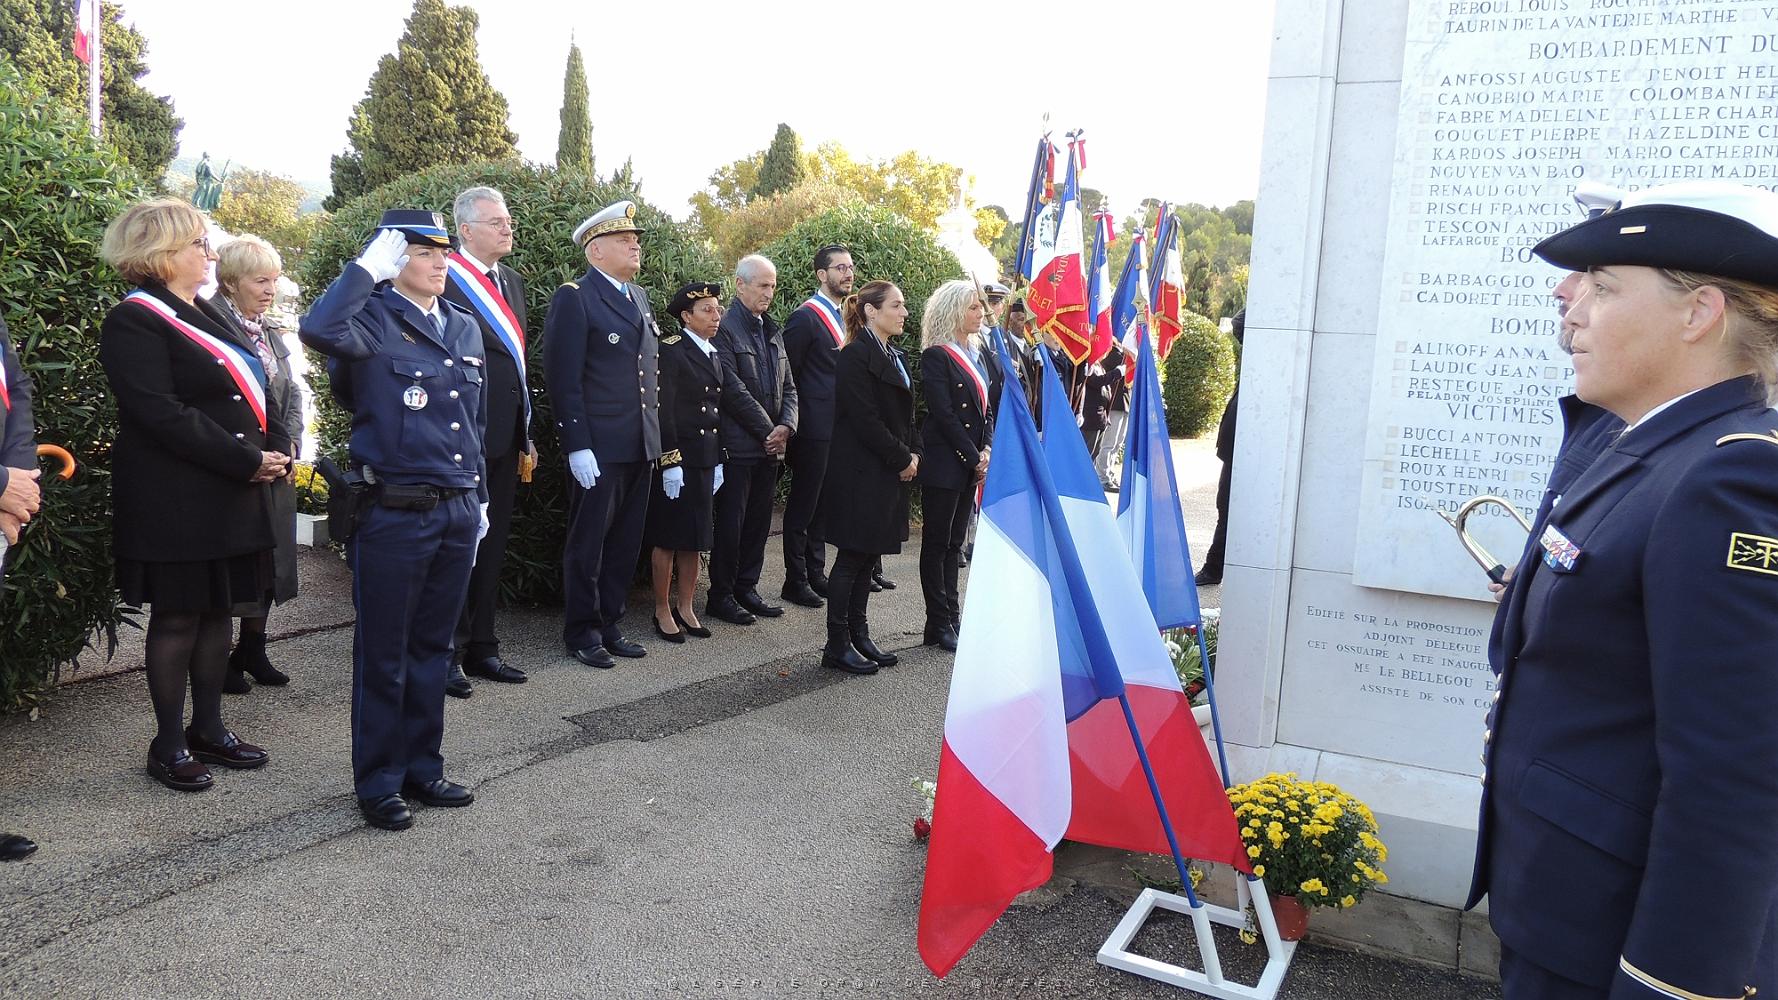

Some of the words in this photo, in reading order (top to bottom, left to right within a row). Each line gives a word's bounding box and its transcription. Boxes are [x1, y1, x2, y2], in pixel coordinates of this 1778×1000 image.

[1449, 1, 1512, 15] REBOUL
[1519, 0, 1569, 12] LOUIS
[1445, 18, 1508, 33] TAURIN
[1513, 18, 1533, 30] DE
[1539, 17, 1560, 30] LA
[1565, 12, 1653, 29] VANTERIE
[1659, 9, 1737, 26] MARTHE
[1761, 8, 1778, 19] V
[1528, 36, 1733, 59] BOMBARDEMENT
[1440, 73, 1525, 87] ANFOSSI
[1531, 70, 1621, 84] AUGUSTE
[1542, 89, 1603, 103] MARIE
[1630, 86, 1751, 102] COLOMBANI
[1437, 111, 1494, 124] FABRE
[1500, 108, 1609, 123] MADELEINE
[1531, 128, 1601, 141] PIERRE
[1628, 125, 1750, 140] HAZELDINE
[1432, 147, 1505, 160] KARDOS
[1512, 147, 1582, 160] JOSEPH
[1430, 165, 1502, 178] NGUYEN
[1508, 165, 1541, 178] VAN
[1546, 165, 1584, 178] BAO
[1611, 165, 1703, 178] PAGLIERI
[1430, 184, 1499, 197] RENAUD
[1504, 185, 1542, 196] GUY
[1427, 202, 1482, 215] RISCH
[1490, 203, 1571, 216] FRANCIS
[1424, 220, 1508, 233] TESCONI
[1501, 246, 1538, 263] BO
[1419, 273, 1535, 288] BARBAGGIO
[1545, 276, 1565, 288] G
[1417, 291, 1502, 305] CADORET
[1490, 317, 1556, 336] BOMB
[1494, 347, 1550, 361] ANNA
[1411, 360, 1477, 375] LAUDIC
[1485, 364, 1538, 378] JEAN
[1407, 391, 1470, 401] PELABON
[1447, 403, 1554, 425] VICTIMES
[1403, 427, 1454, 442] BUCCI
[1461, 432, 1542, 447] ANTONIN
[1401, 445, 1481, 462] LECHELLE
[1400, 462, 1446, 477] ROUX
[1454, 466, 1509, 481] HENRI
[1400, 479, 1478, 496] TOUSTEN
[1353, 613, 1377, 626] SUR
[1383, 618, 1399, 627] LA
[1406, 620, 1484, 637] PROPOSITION
[1364, 631, 1415, 646] ADJOINT
[1425, 639, 1481, 654] DELEGUE
[1307, 640, 1328, 650] CET
[1336, 644, 1390, 659] OSSUAIRE
[1398, 652, 1404, 661] A
[1412, 654, 1434, 665] ETE
[1401, 669, 1473, 688] BELLEGOU
[1485, 680, 1499, 691] E
[1359, 684, 1410, 699] ASSISTE
[1419, 691, 1434, 701] DE
[1442, 696, 1465, 706] SON
